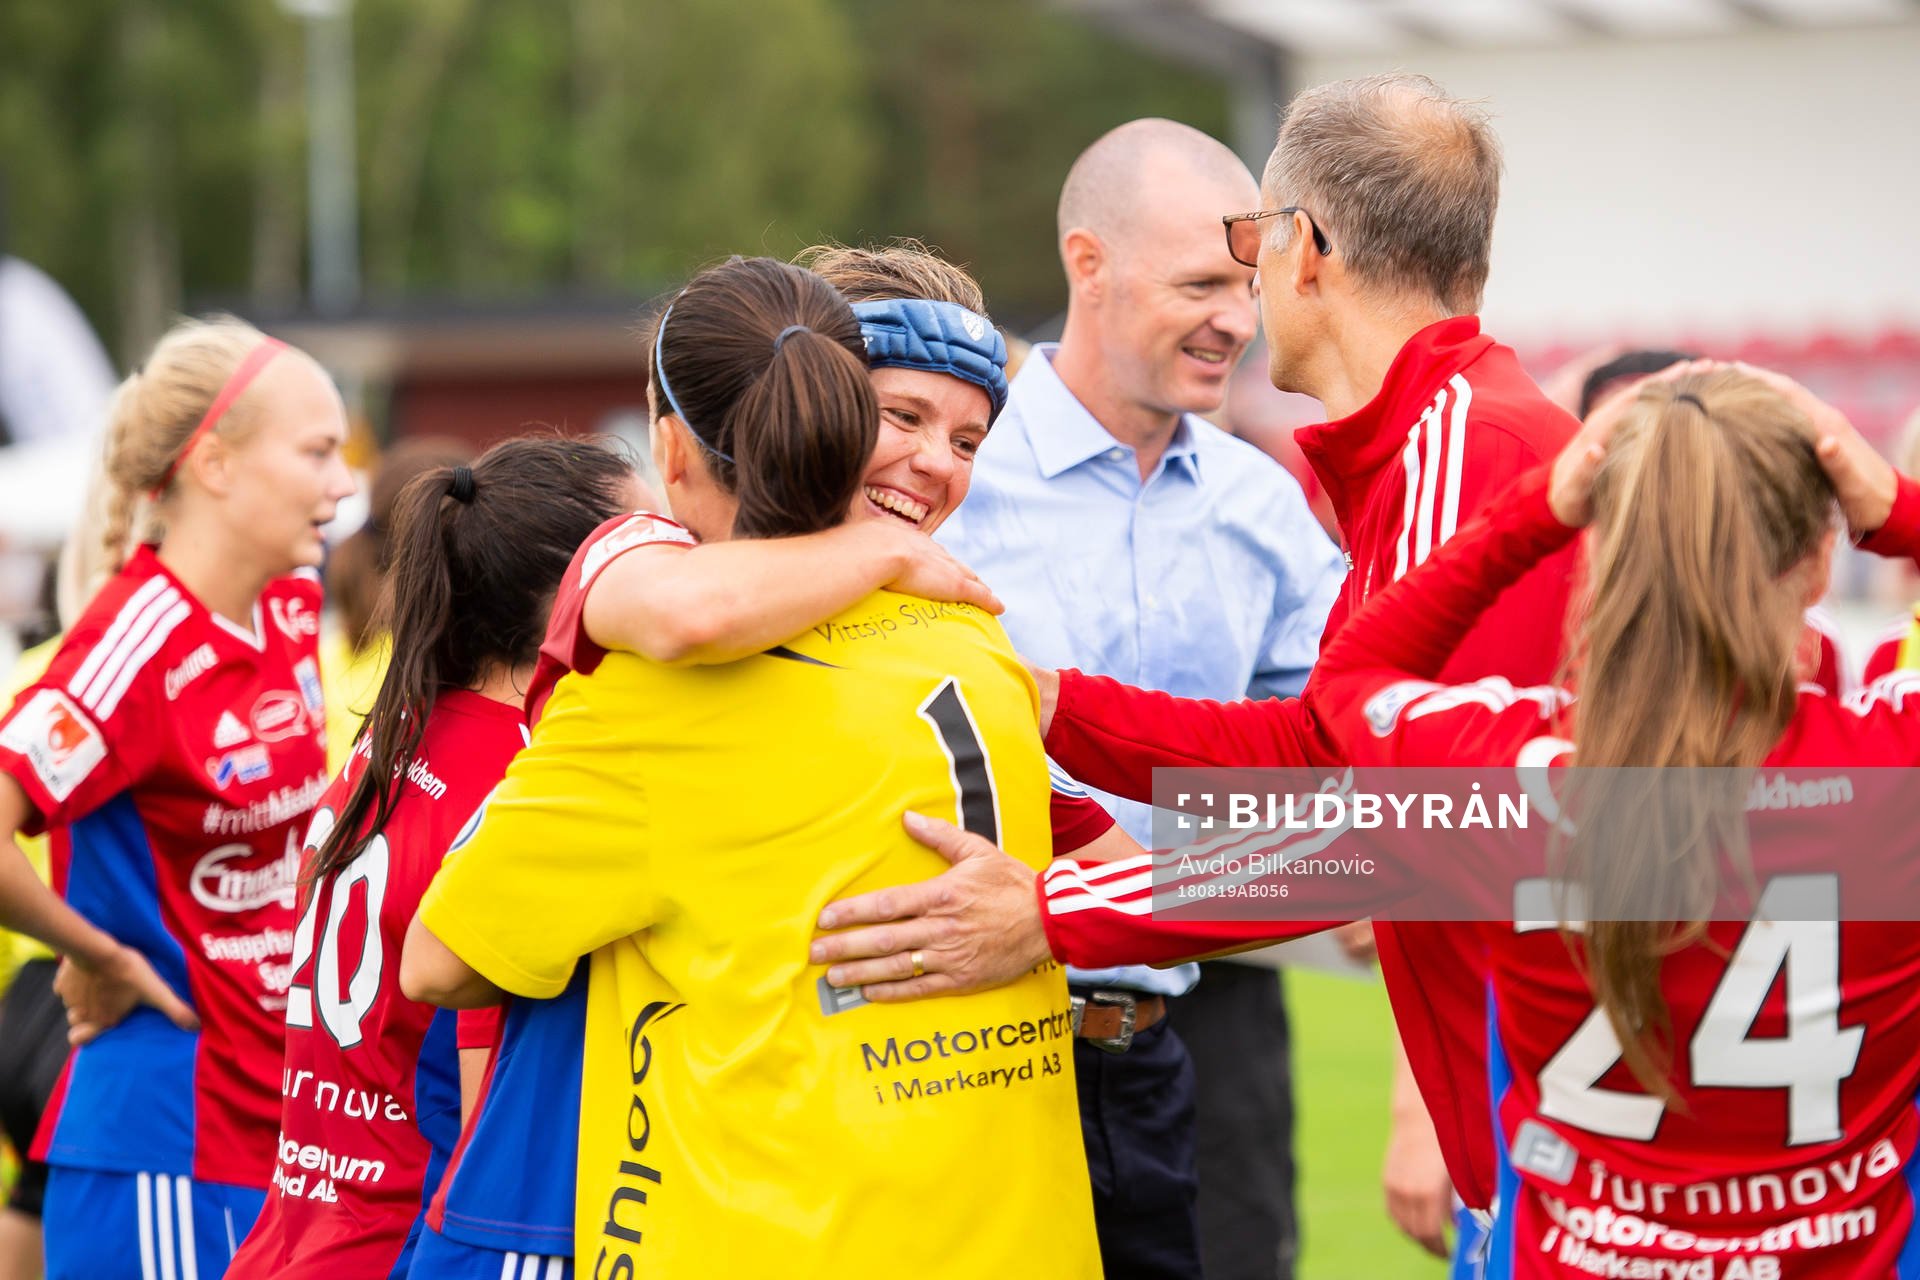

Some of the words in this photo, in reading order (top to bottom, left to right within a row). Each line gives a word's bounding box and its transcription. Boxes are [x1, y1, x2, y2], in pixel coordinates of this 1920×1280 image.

[813, 612, 897, 643] Vittsjö
[916, 675, 1003, 850] 1
[285, 805, 390, 1050] 20
[1512, 873, 1866, 1147] 24
[893, 1058, 1033, 1102] Markaryd
